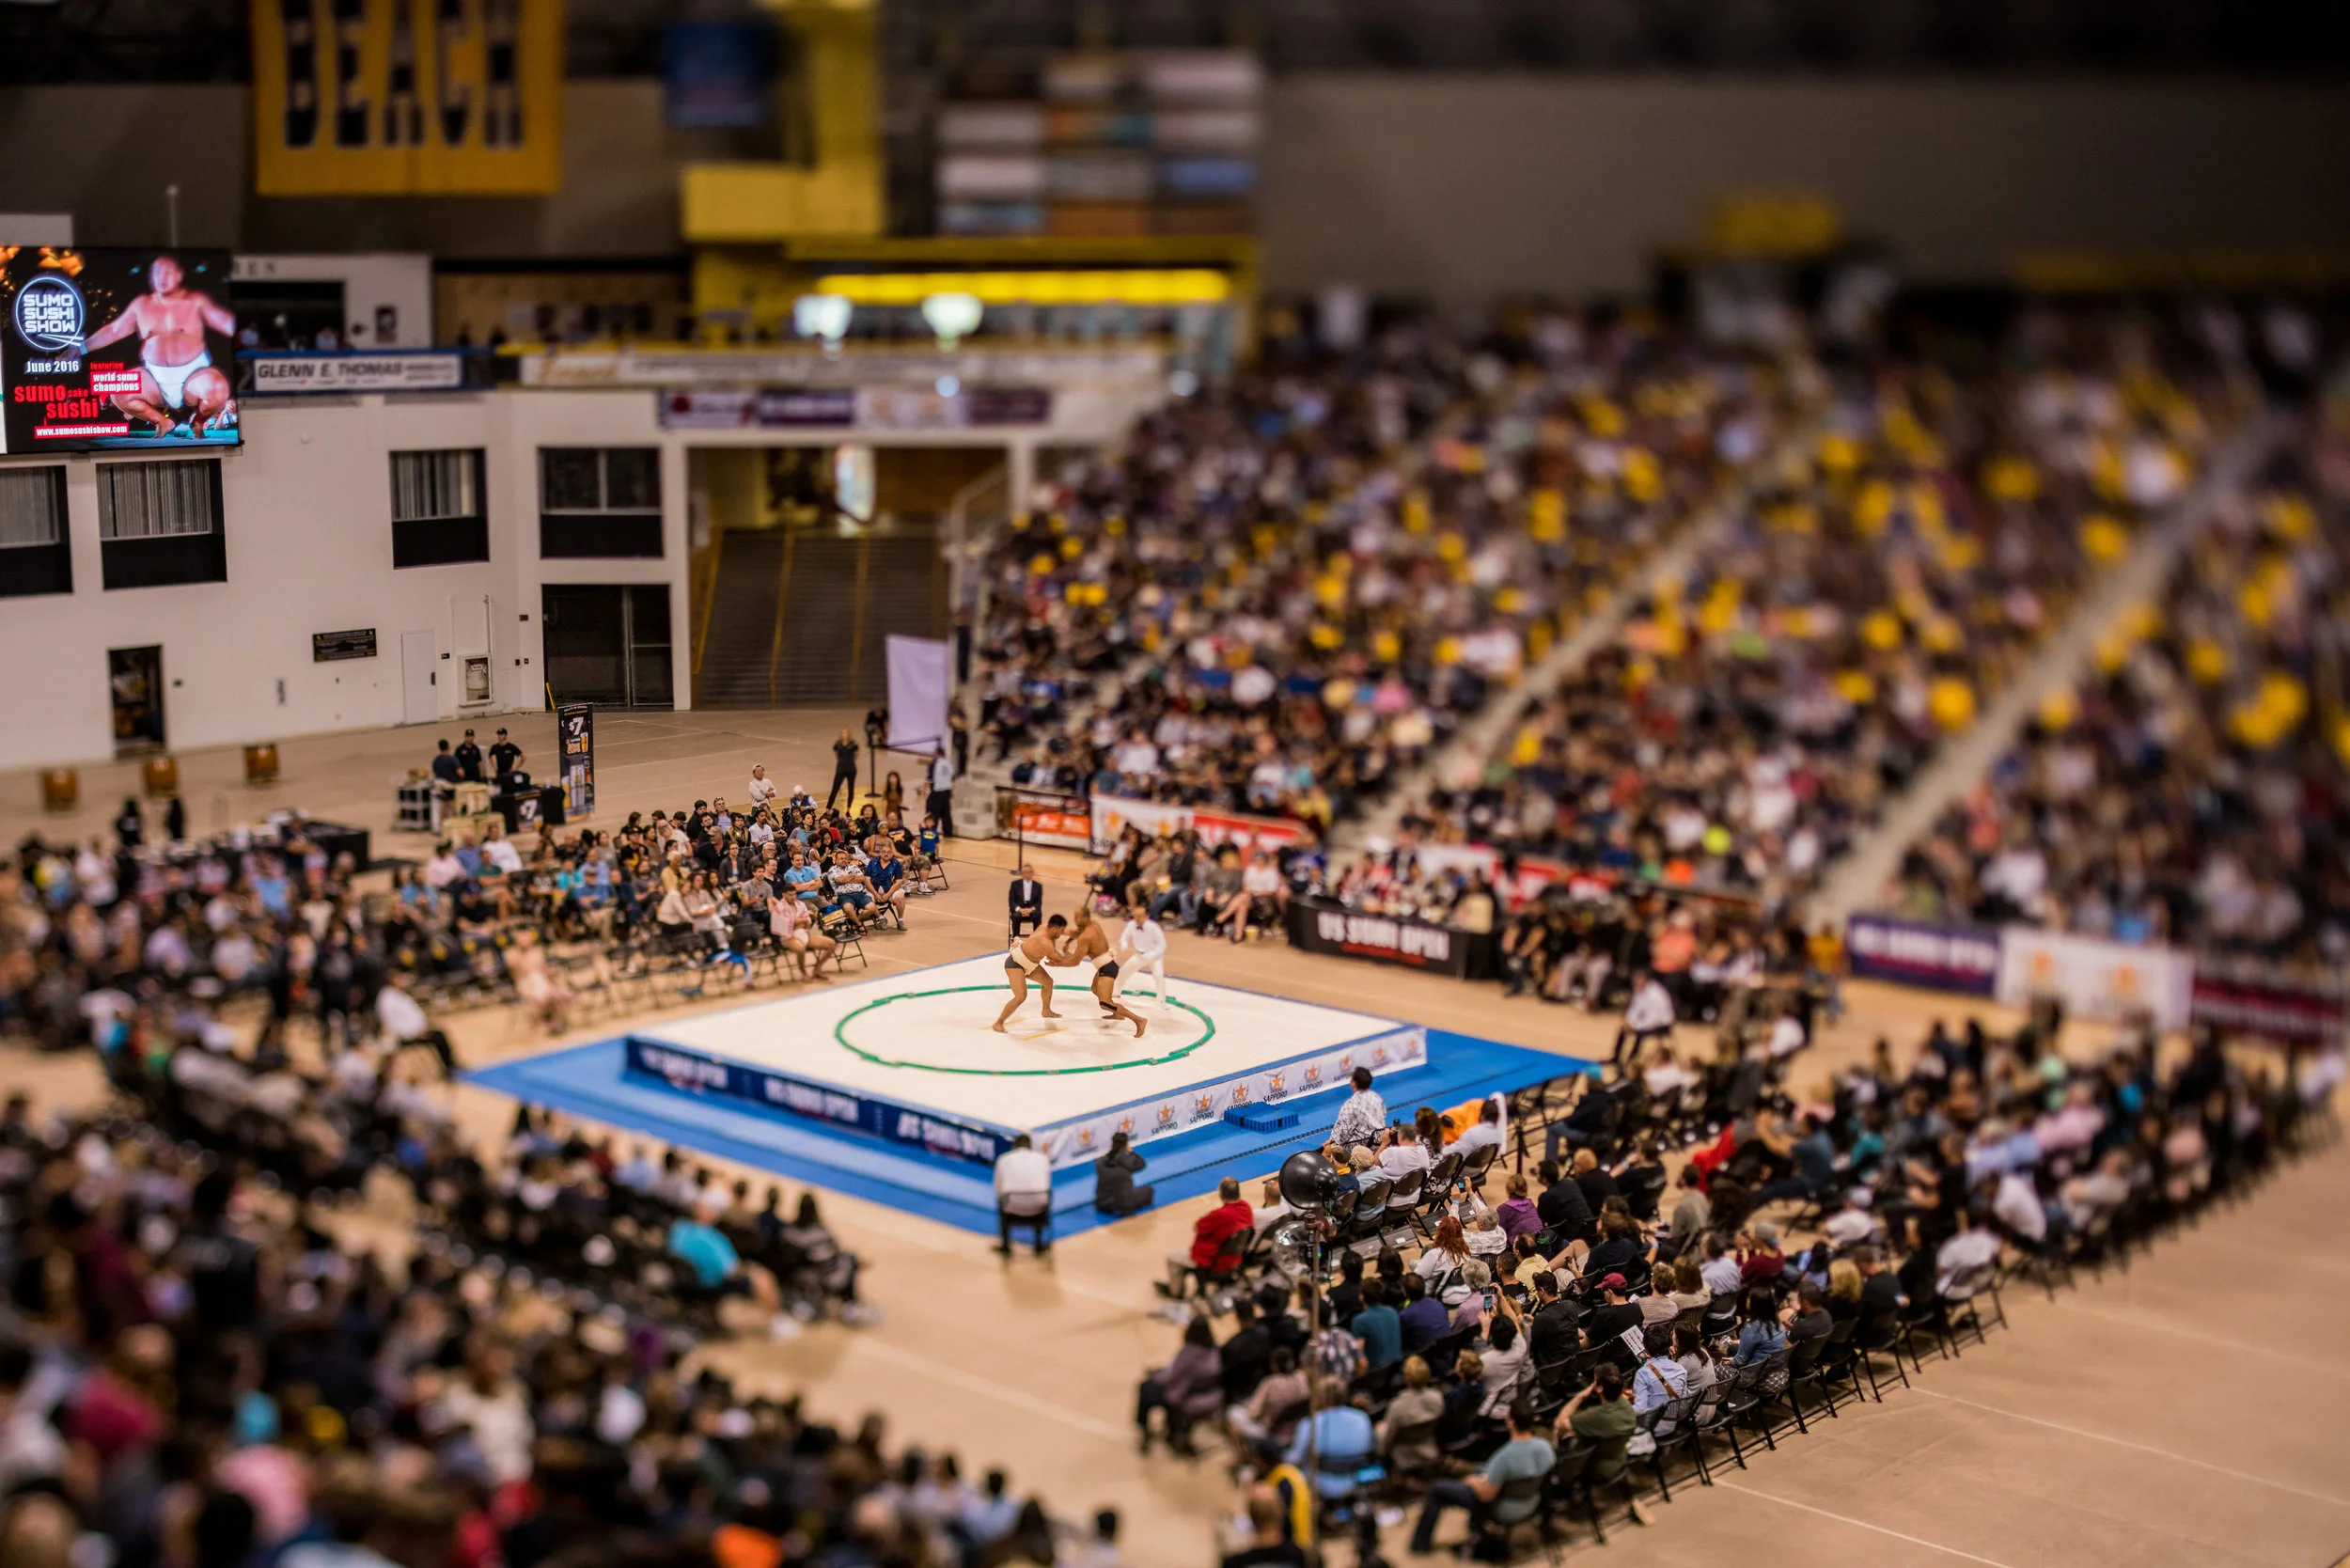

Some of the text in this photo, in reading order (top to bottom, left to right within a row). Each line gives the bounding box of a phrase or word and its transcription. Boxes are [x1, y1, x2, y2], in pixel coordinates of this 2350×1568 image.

[282, 0, 523, 149] BEACH
[24, 294, 74, 306] SUMO
[24, 307, 75, 320] SUSHI
[24, 321, 75, 333] SHOW
[26, 360, 79, 372] June 2016
[258, 364, 315, 378] GLENN
[338, 362, 402, 376] THOMAS
[93, 372, 138, 382] world sumo
[14, 384, 67, 402] sumo
[93, 382, 140, 392] champions
[46, 398, 99, 419] sushi
[36, 426, 128, 436] www.sumosushishow.com
[569, 716, 584, 736] $7
[1298, 1080, 1323, 1093] SAPPORO
[1263, 1090, 1288, 1103] SAPPORO
[1188, 1110, 1214, 1125] SAPPORO
[1151, 1121, 1178, 1136] SAPPORO
